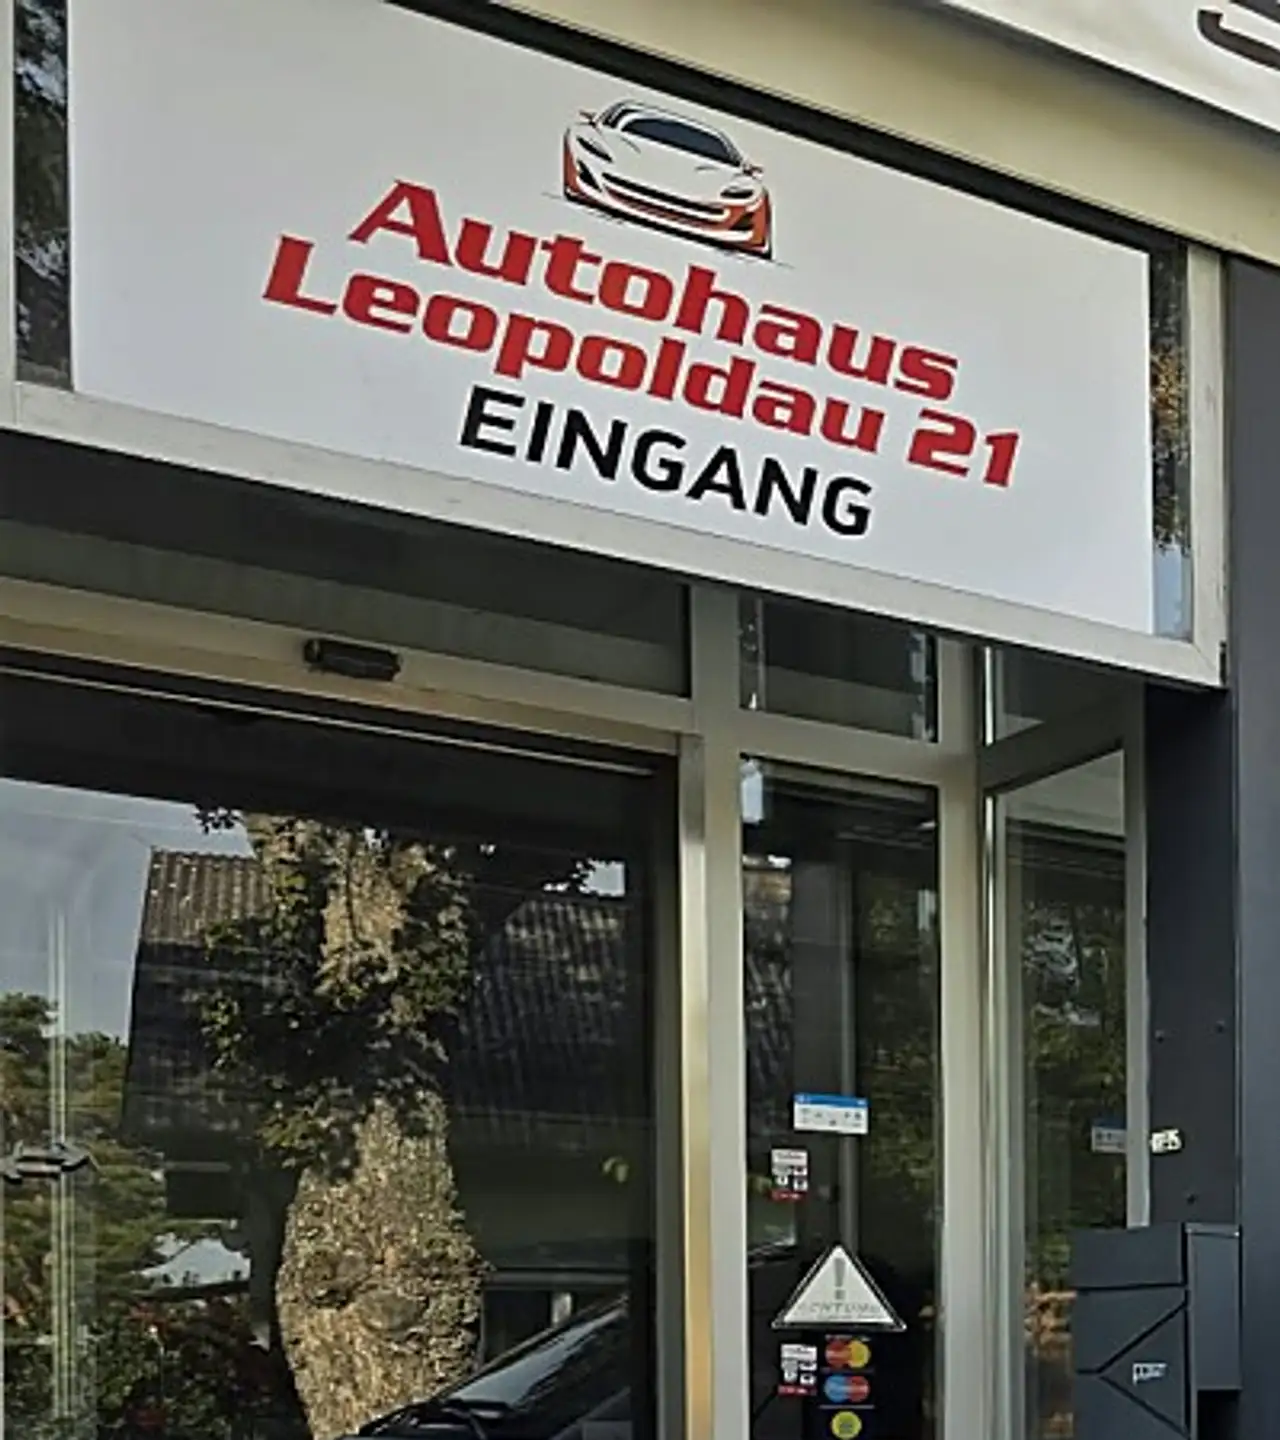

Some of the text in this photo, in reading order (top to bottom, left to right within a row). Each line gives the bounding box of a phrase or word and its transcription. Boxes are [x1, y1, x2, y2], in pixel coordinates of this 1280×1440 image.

[261, 233, 1021, 489] Leopoldau 21
[348, 178, 960, 402] Autohaus
[458, 385, 874, 538] EINGANG
